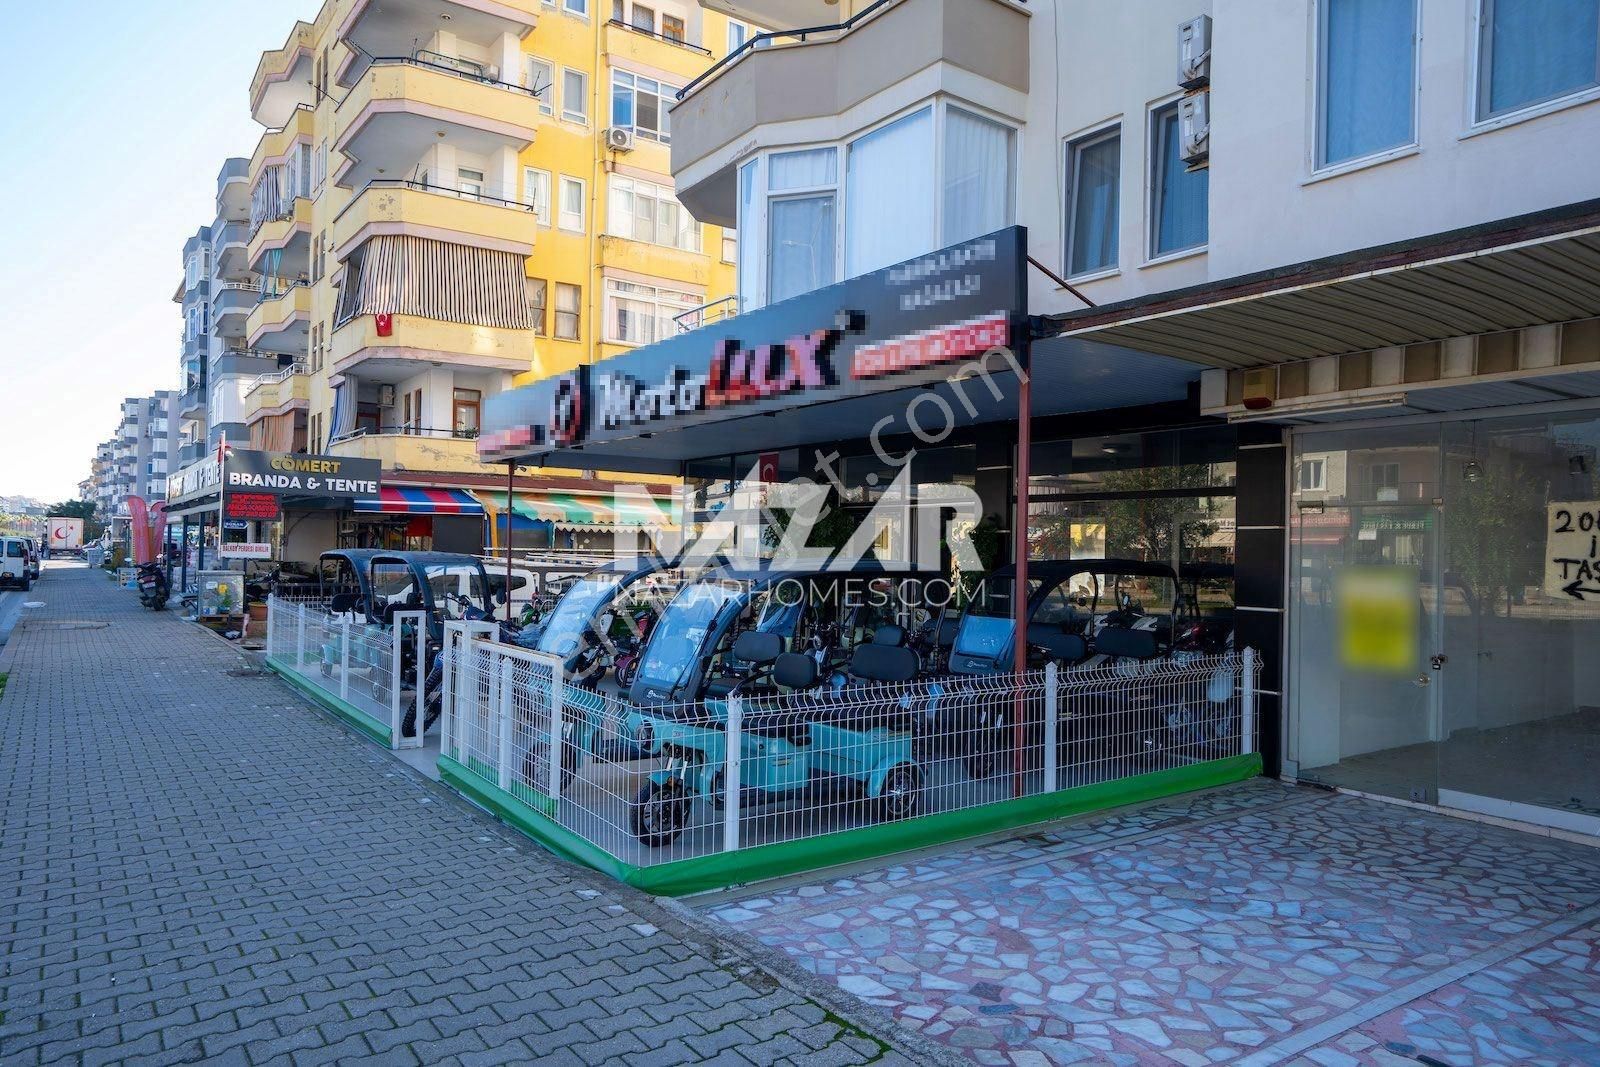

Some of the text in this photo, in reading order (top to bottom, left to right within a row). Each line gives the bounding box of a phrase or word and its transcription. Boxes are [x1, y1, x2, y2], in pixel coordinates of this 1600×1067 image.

[271, 455, 341, 474] CÖMERT
[229, 472, 377, 493] BRANDA & TENTE
[1555, 510, 1600, 533] 20
